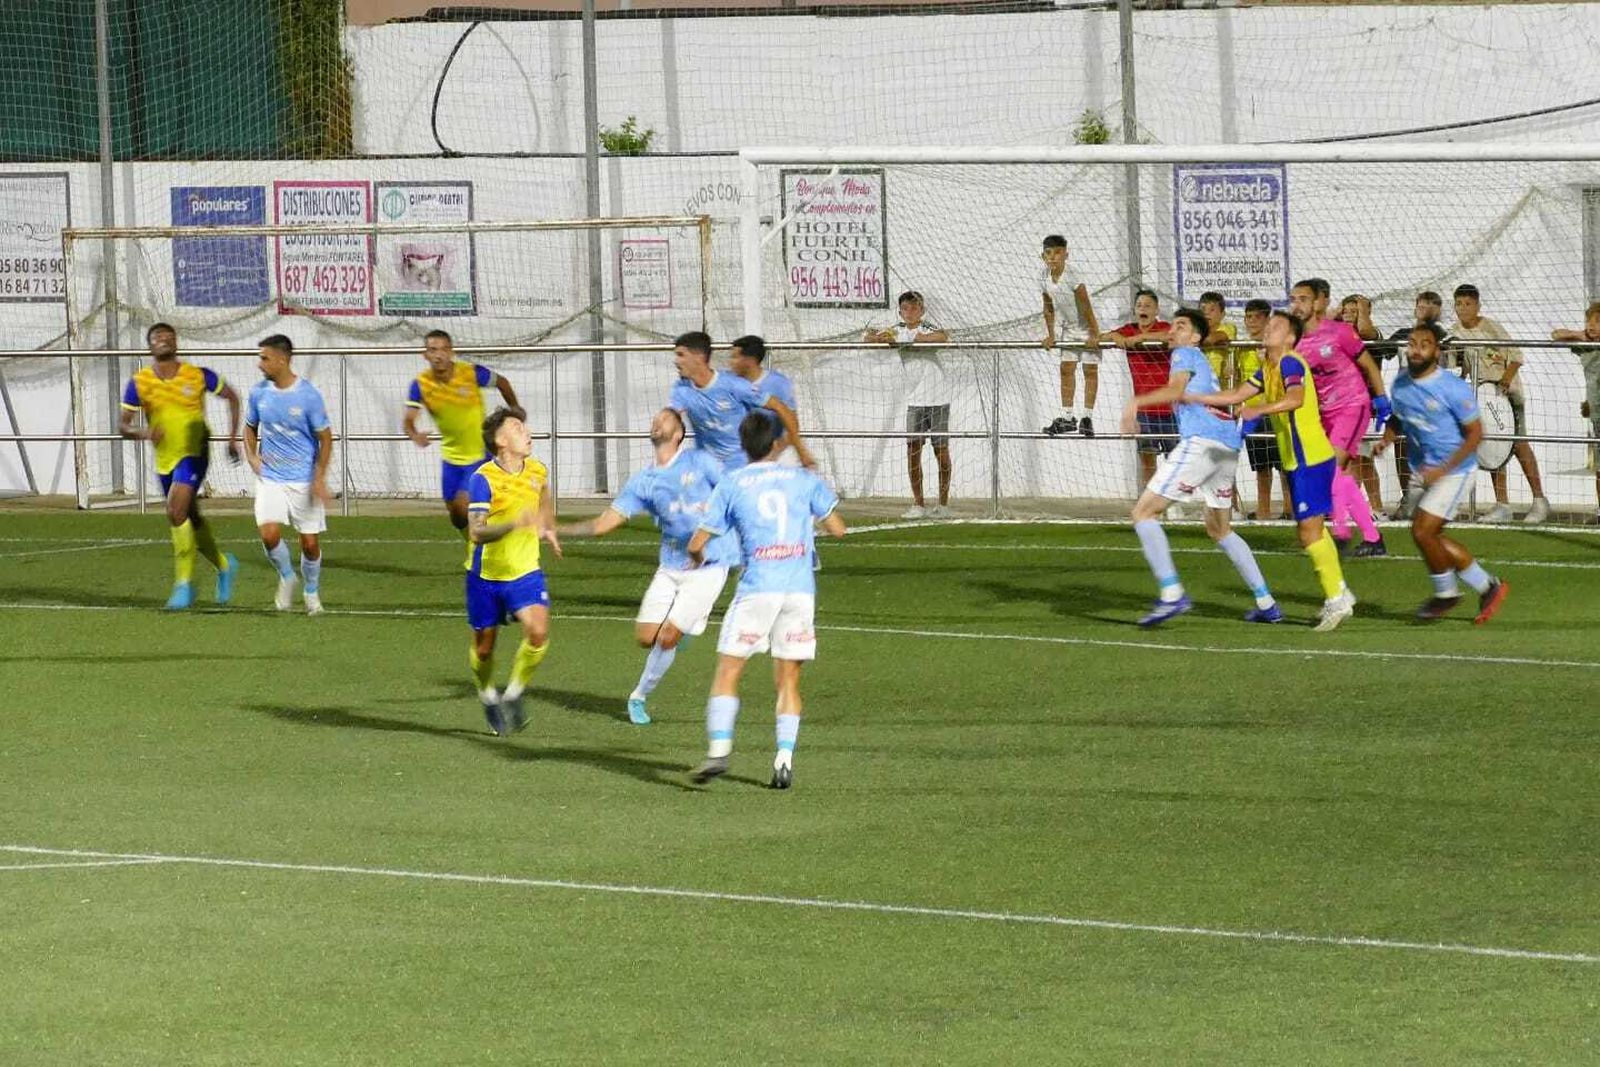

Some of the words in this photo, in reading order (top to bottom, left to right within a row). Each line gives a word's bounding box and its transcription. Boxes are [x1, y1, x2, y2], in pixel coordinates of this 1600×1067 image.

[1202, 177, 1271, 200] nebreda
[191, 198, 247, 214] populares
[283, 191, 361, 216] DISTRIBUCIONES
[796, 222, 874, 234] HOTEL
[1184, 211, 1212, 230] 856
[1216, 210, 1246, 229] 046
[1250, 210, 1277, 229] 341
[792, 236, 880, 248] FUERTE
[1185, 234, 1213, 252] 956
[1219, 233, 1246, 252] 444
[1251, 233, 1279, 252] 193
[798, 250, 872, 262] CONIL
[14, 259, 29, 273] 80
[32, 259, 47, 273] 36
[15, 279, 29, 293] 84
[33, 279, 47, 293] 71
[285, 265, 308, 293] 687
[313, 265, 338, 293] 462
[340, 265, 367, 293] 329
[791, 266, 818, 297] 956
[823, 266, 849, 297] 443
[854, 266, 881, 297] 466
[758, 489, 787, 544] 9
